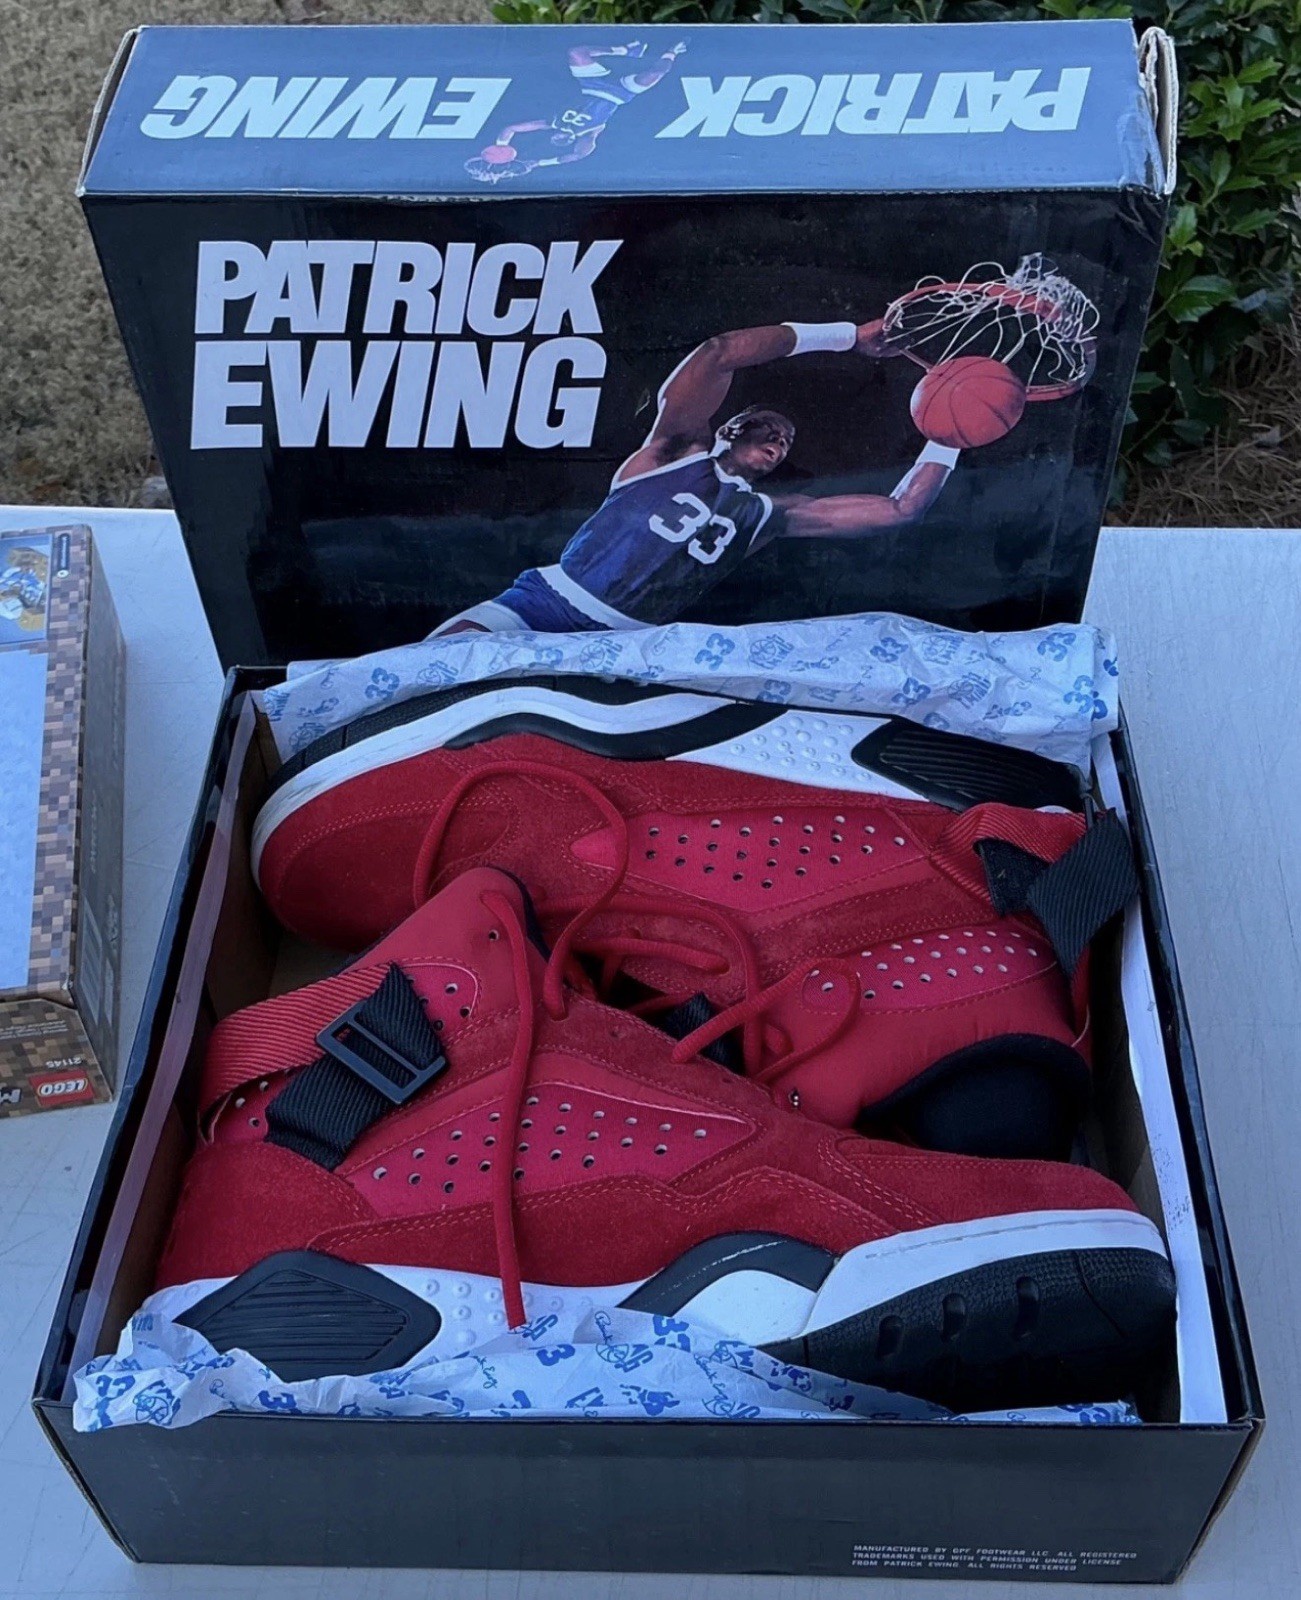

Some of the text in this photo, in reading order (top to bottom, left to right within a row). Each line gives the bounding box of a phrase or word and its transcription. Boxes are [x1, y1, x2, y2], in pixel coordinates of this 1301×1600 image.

[141, 67, 1091, 139] PATRICK EWING
[194, 239, 623, 335] PATRICK
[190, 337, 607, 450] EWING
[648, 491, 737, 565] 33
[46, 1056, 82, 1069] 21145
[40, 1079, 86, 1096] LEGO
[854, 1544, 929, 1553] MANUFACTURED
[852, 1559, 878, 1567] FROM
[853, 1552, 915, 1560] TRADEMARKS
[980, 1555, 1039, 1563] PERMISSION
